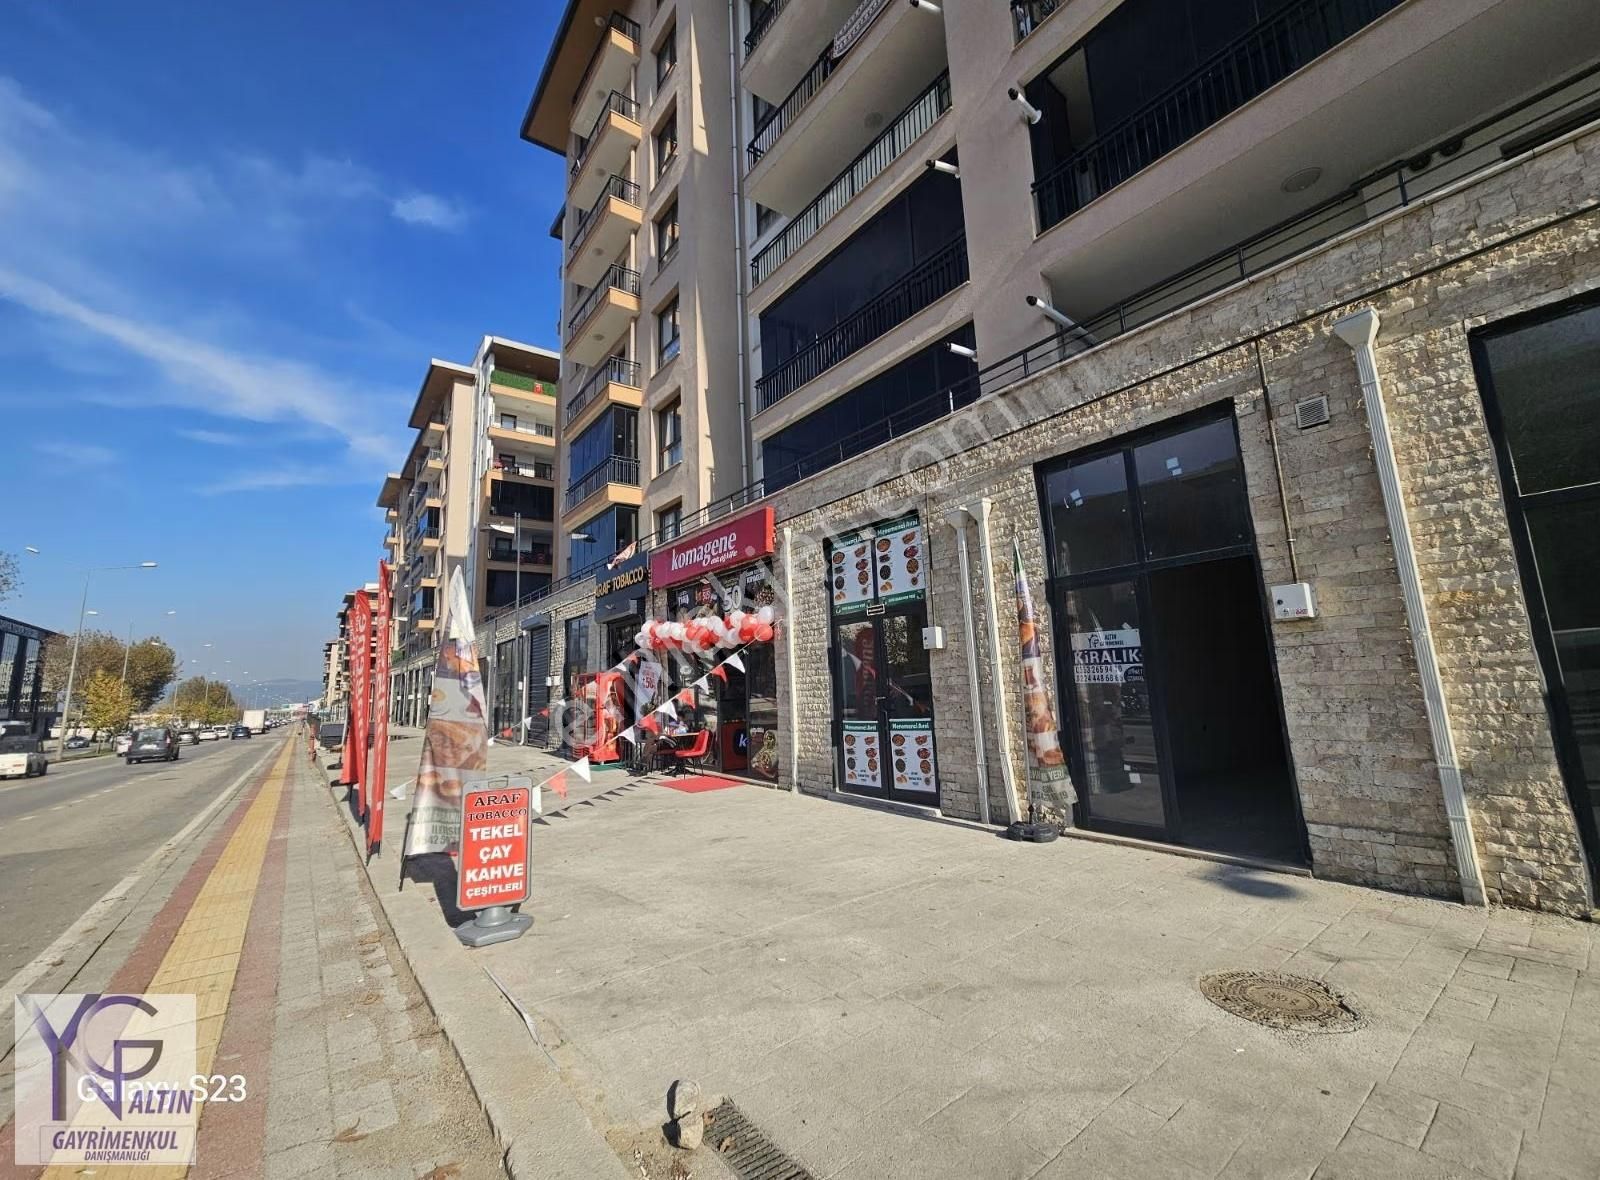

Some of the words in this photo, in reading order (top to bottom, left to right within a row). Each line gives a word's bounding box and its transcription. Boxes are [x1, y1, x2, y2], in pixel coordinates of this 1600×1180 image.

[671, 532, 737, 571] komagene
[613, 566, 644, 591] TOBACCO
[474, 793, 521, 807] ARAF
[468, 808, 527, 822] TOBACCO
[469, 824, 523, 841] TEKEL
[479, 844, 512, 864] ÇAY
[465, 863, 524, 883] KAHVE
[465, 880, 523, 900] ÇEŞİTLERİ
